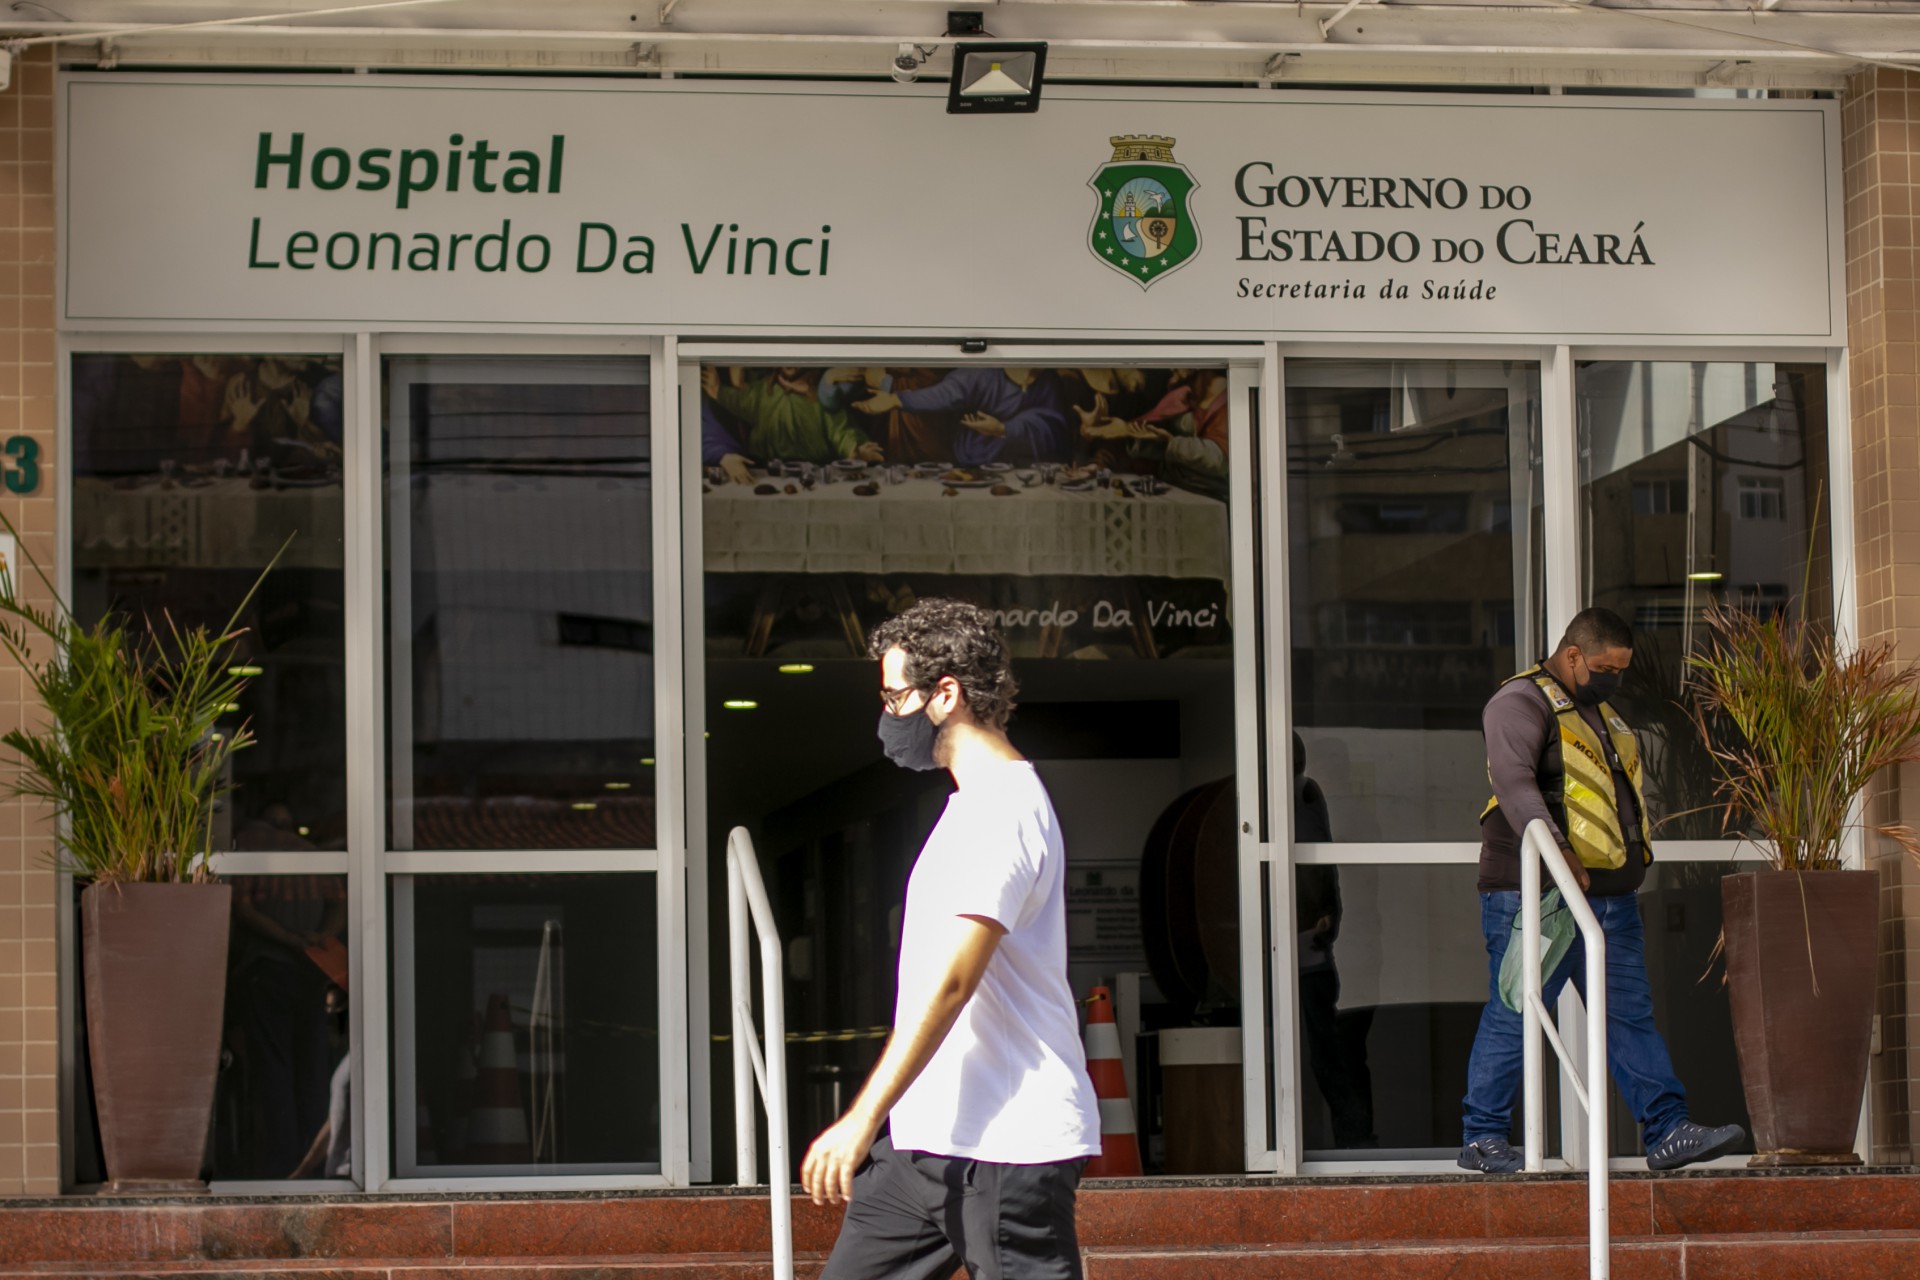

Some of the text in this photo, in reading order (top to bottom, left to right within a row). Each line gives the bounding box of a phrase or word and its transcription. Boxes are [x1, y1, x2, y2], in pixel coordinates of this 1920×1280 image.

[254, 131, 565, 209] Hospital
[1234, 161, 1532, 210] GOVERNO DO
[248, 217, 832, 276] Leonardo Da Vinci
[1235, 216, 1656, 265] ESTADO DO CEARÁ
[1236, 277, 1497, 300] Secretaria da Saúde
[0, 436, 39, 494] 3
[988, 601, 1218, 627] nardo Da Vinci
[1573, 740, 1607, 774] MOTO
